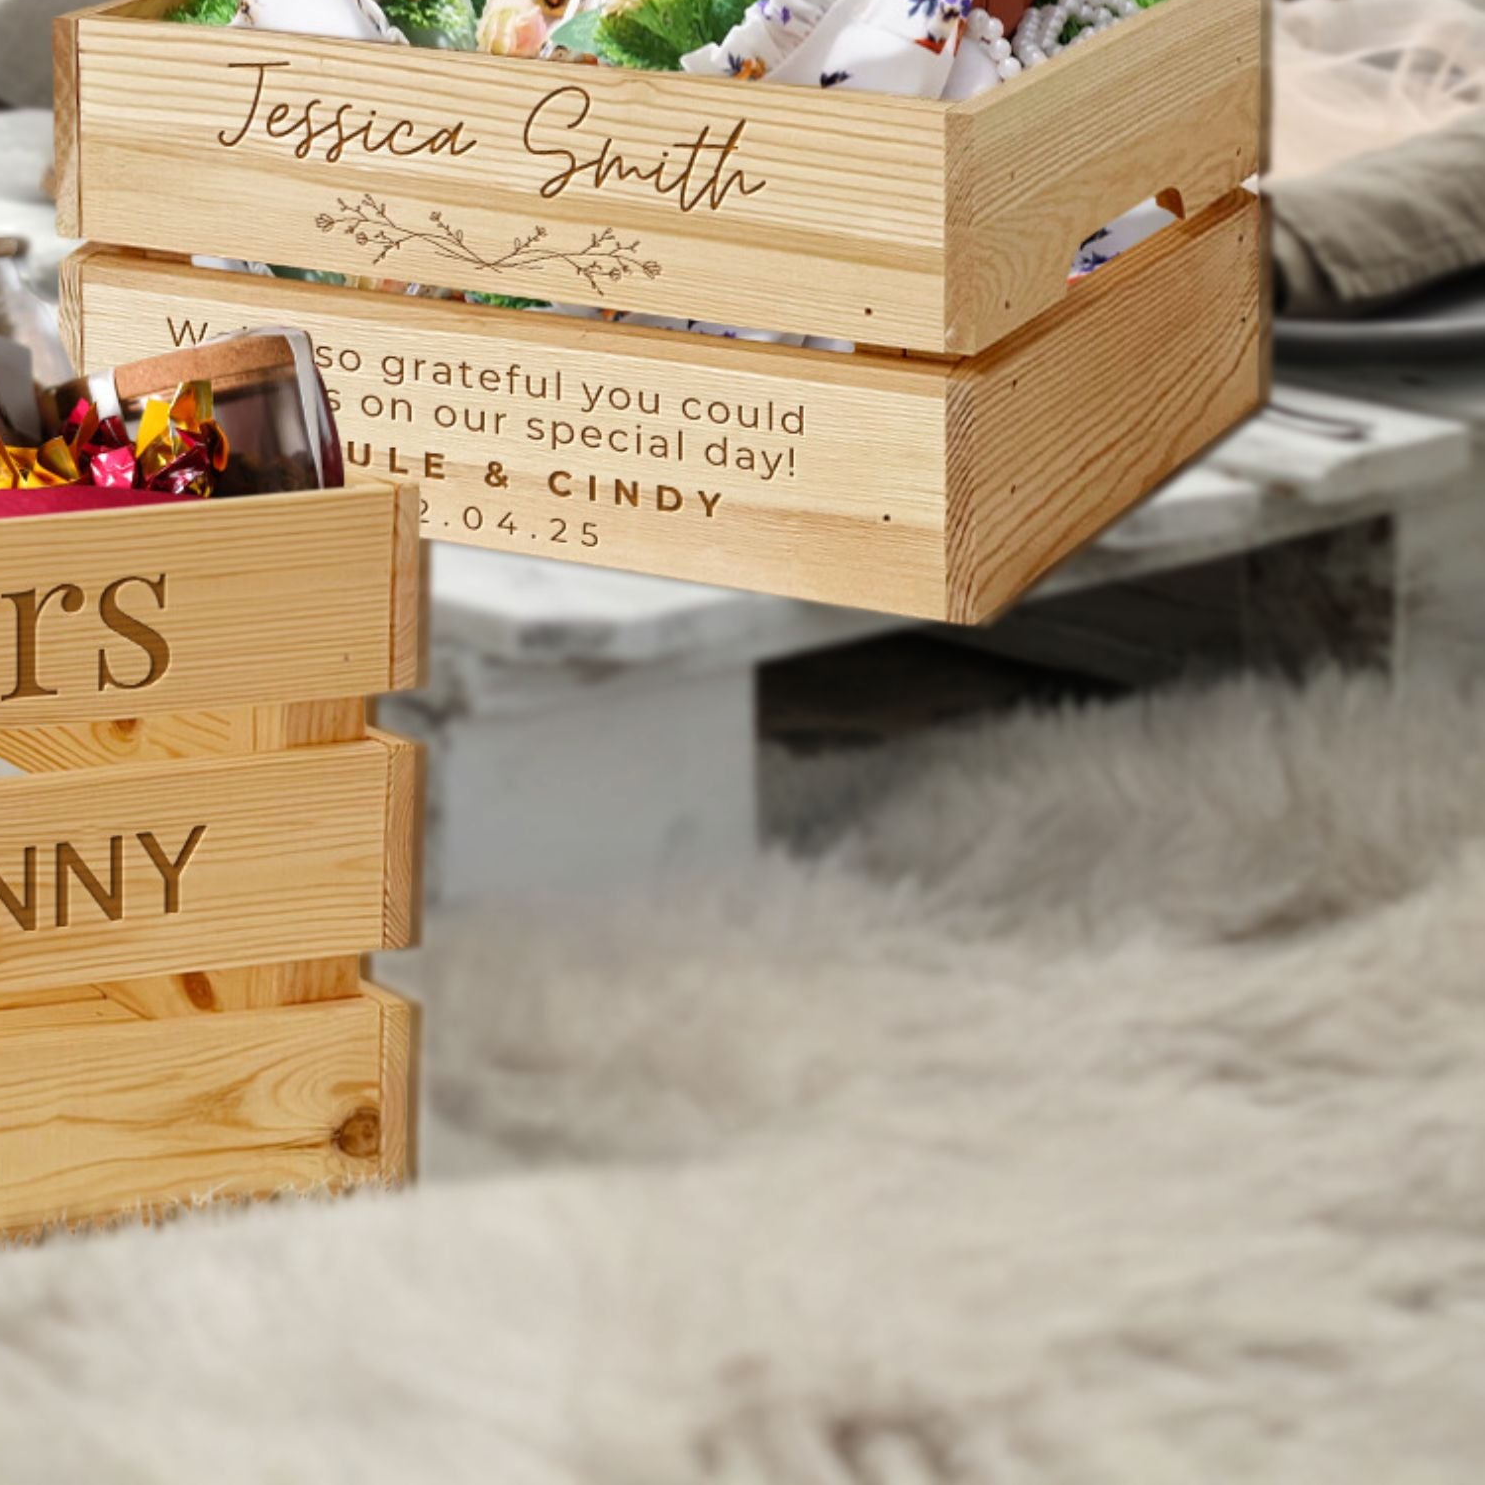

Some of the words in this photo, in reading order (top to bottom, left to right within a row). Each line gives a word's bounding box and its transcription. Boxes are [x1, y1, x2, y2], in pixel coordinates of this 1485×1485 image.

[218, 61, 477, 163] Jessica
[523, 85, 766, 213] Smith
[315, 345, 362, 372] so
[381, 355, 562, 402] grateful
[580, 381, 661, 414] you
[681, 390, 806, 436] could
[326, 388, 342, 413] s
[360, 394, 413, 423] on
[433, 404, 508, 436] our
[526, 416, 684, 461] special
[704, 436, 796, 481] day!
[346, 440, 446, 480] ULE
[483, 460, 509, 490] &
[547, 469, 722, 518] CINDY
